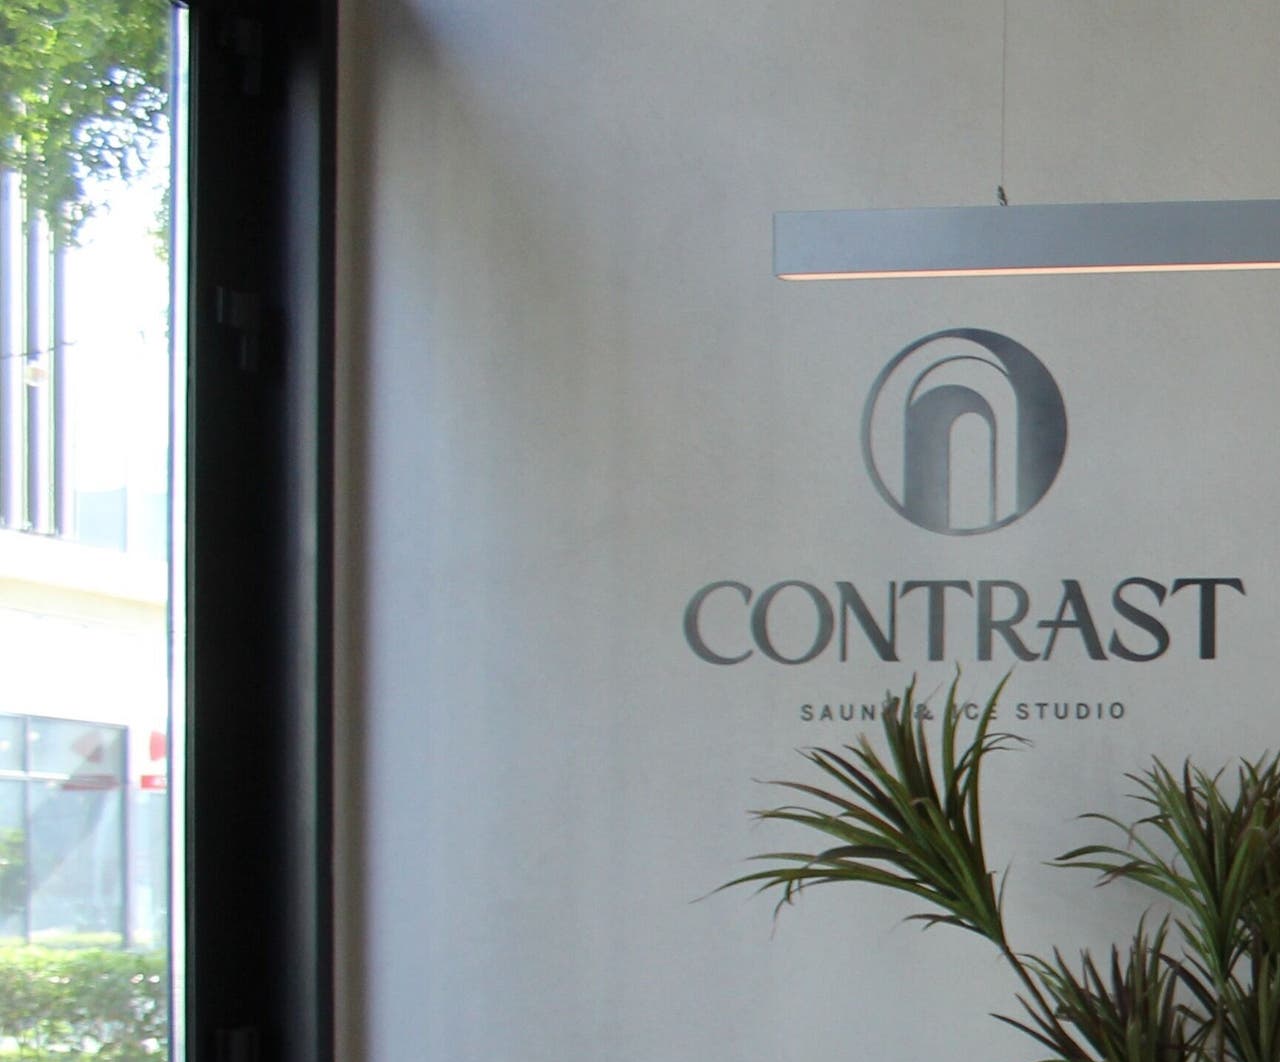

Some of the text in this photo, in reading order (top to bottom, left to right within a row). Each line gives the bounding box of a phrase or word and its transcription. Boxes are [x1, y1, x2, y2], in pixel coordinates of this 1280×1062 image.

[682, 576, 1247, 666] CONTRAST
[800, 703, 897, 721] SAUN
[1015, 701, 1126, 721] STUDIO
